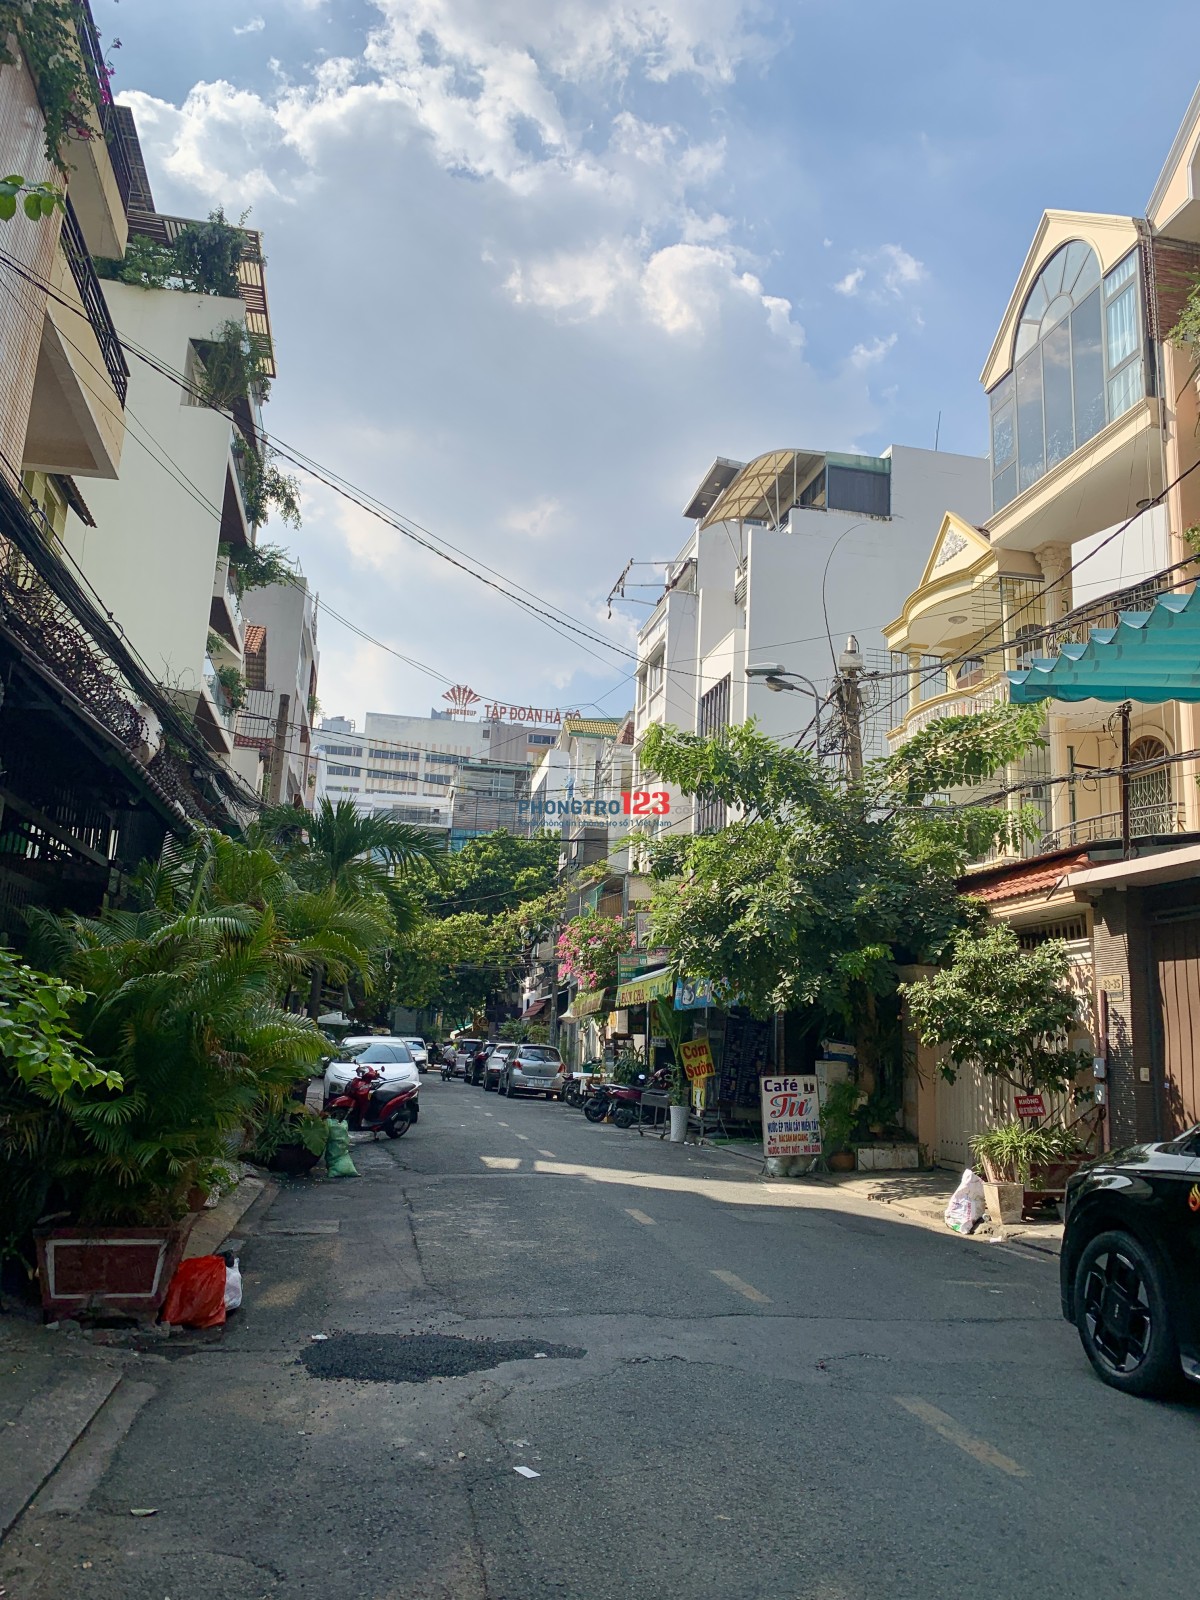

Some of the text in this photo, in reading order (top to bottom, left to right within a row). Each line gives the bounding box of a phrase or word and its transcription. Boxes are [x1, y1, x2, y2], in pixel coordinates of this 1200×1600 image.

[484, 702, 507, 721] TẬP
[509, 705, 543, 722] ĐOÀN
[545, 707, 561, 724] HÀ
[1103, 978, 1121, 989] 33-35
[682, 1044, 708, 1060] Cơm
[686, 1060, 714, 1078] Sườn
[764, 1078, 798, 1092] Café
[1018, 1097, 1039, 1105] KHÔNG
[779, 1120, 784, 1132] ÉP
